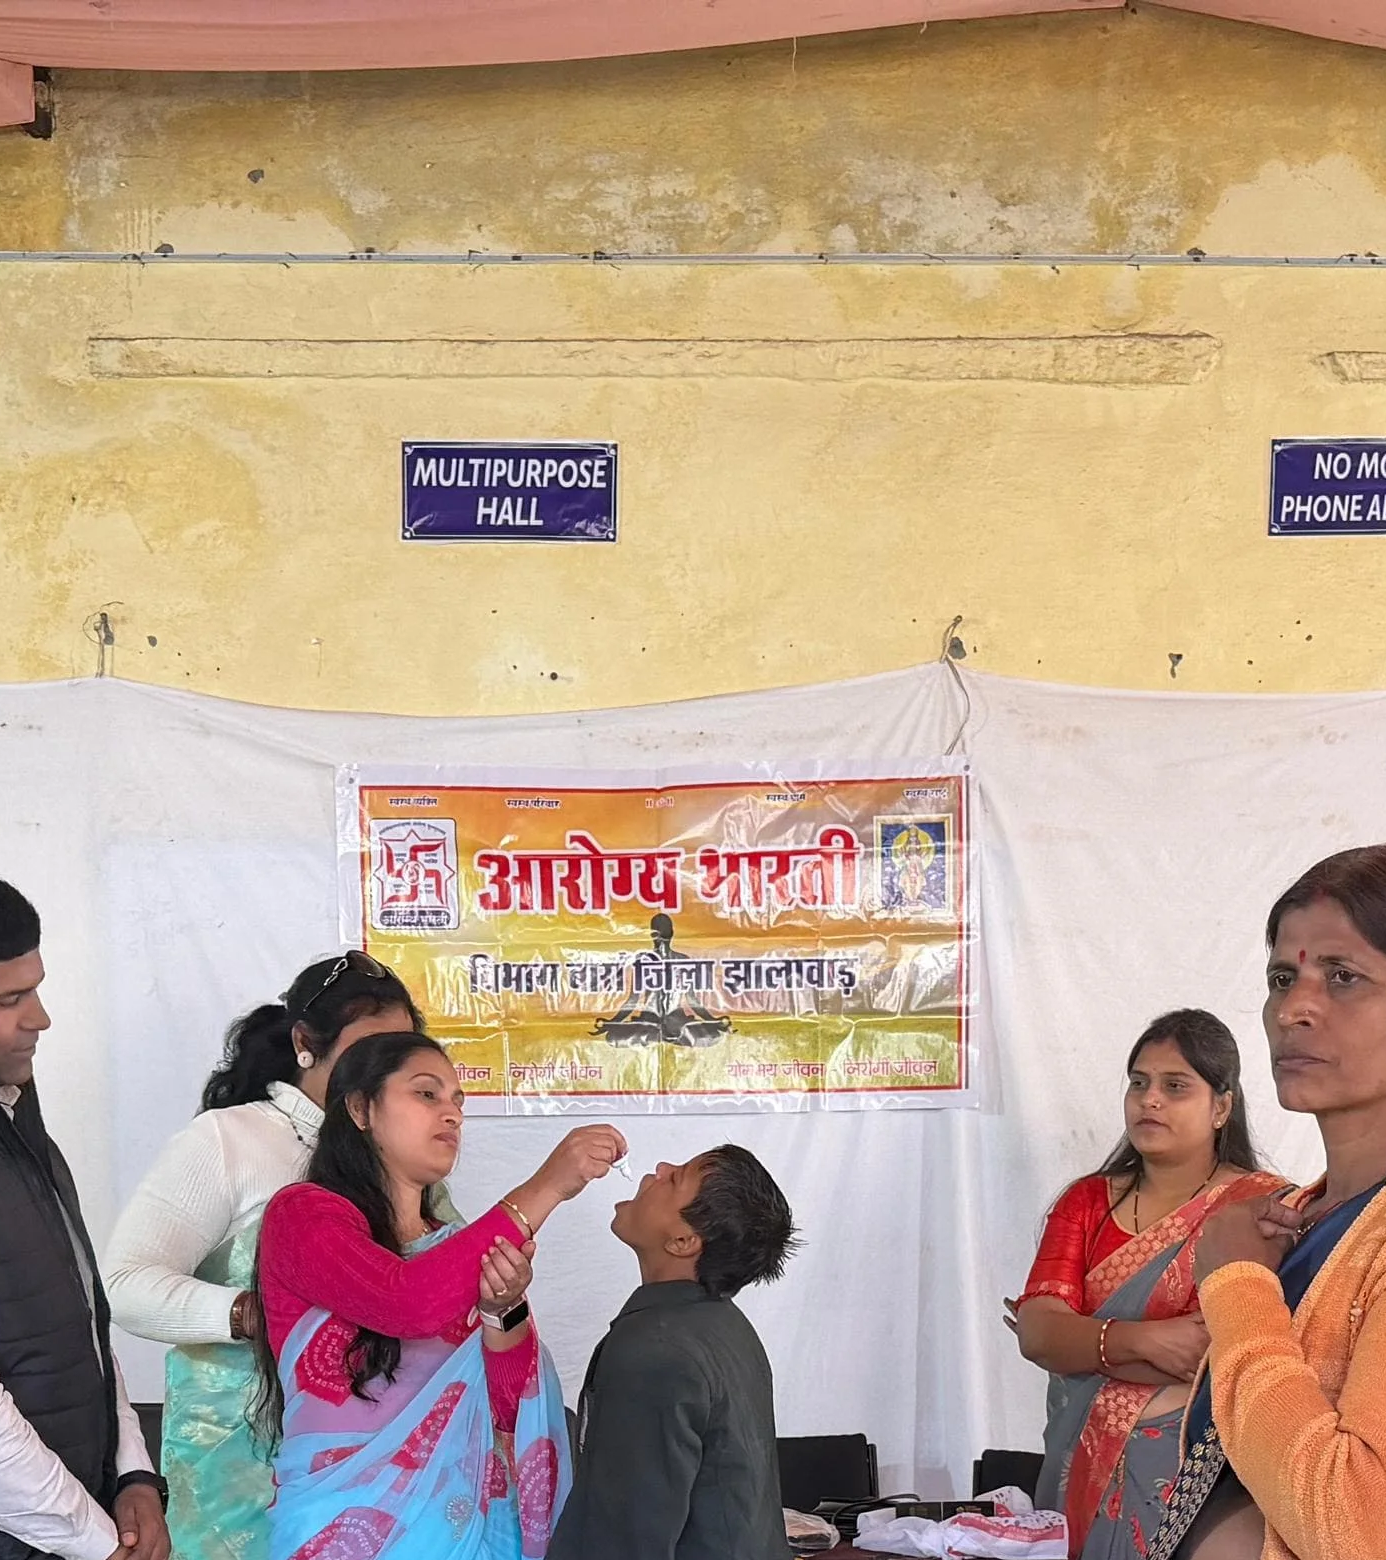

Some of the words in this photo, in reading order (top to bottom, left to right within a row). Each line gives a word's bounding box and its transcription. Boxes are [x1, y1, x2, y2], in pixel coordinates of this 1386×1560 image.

[413, 458, 607, 488] MULTIPURPOSE
[1314, 452, 1351, 480] NO
[476, 496, 544, 526] HALL
[1280, 494, 1364, 523] PHONE
[475, 832, 683, 912] आरोग्य
[697, 826, 862, 910] भारती
[722, 957, 860, 997] झालावाड़
[456, 1063, 491, 1081] ीवन
[892, 1057, 937, 1075] जीवन
